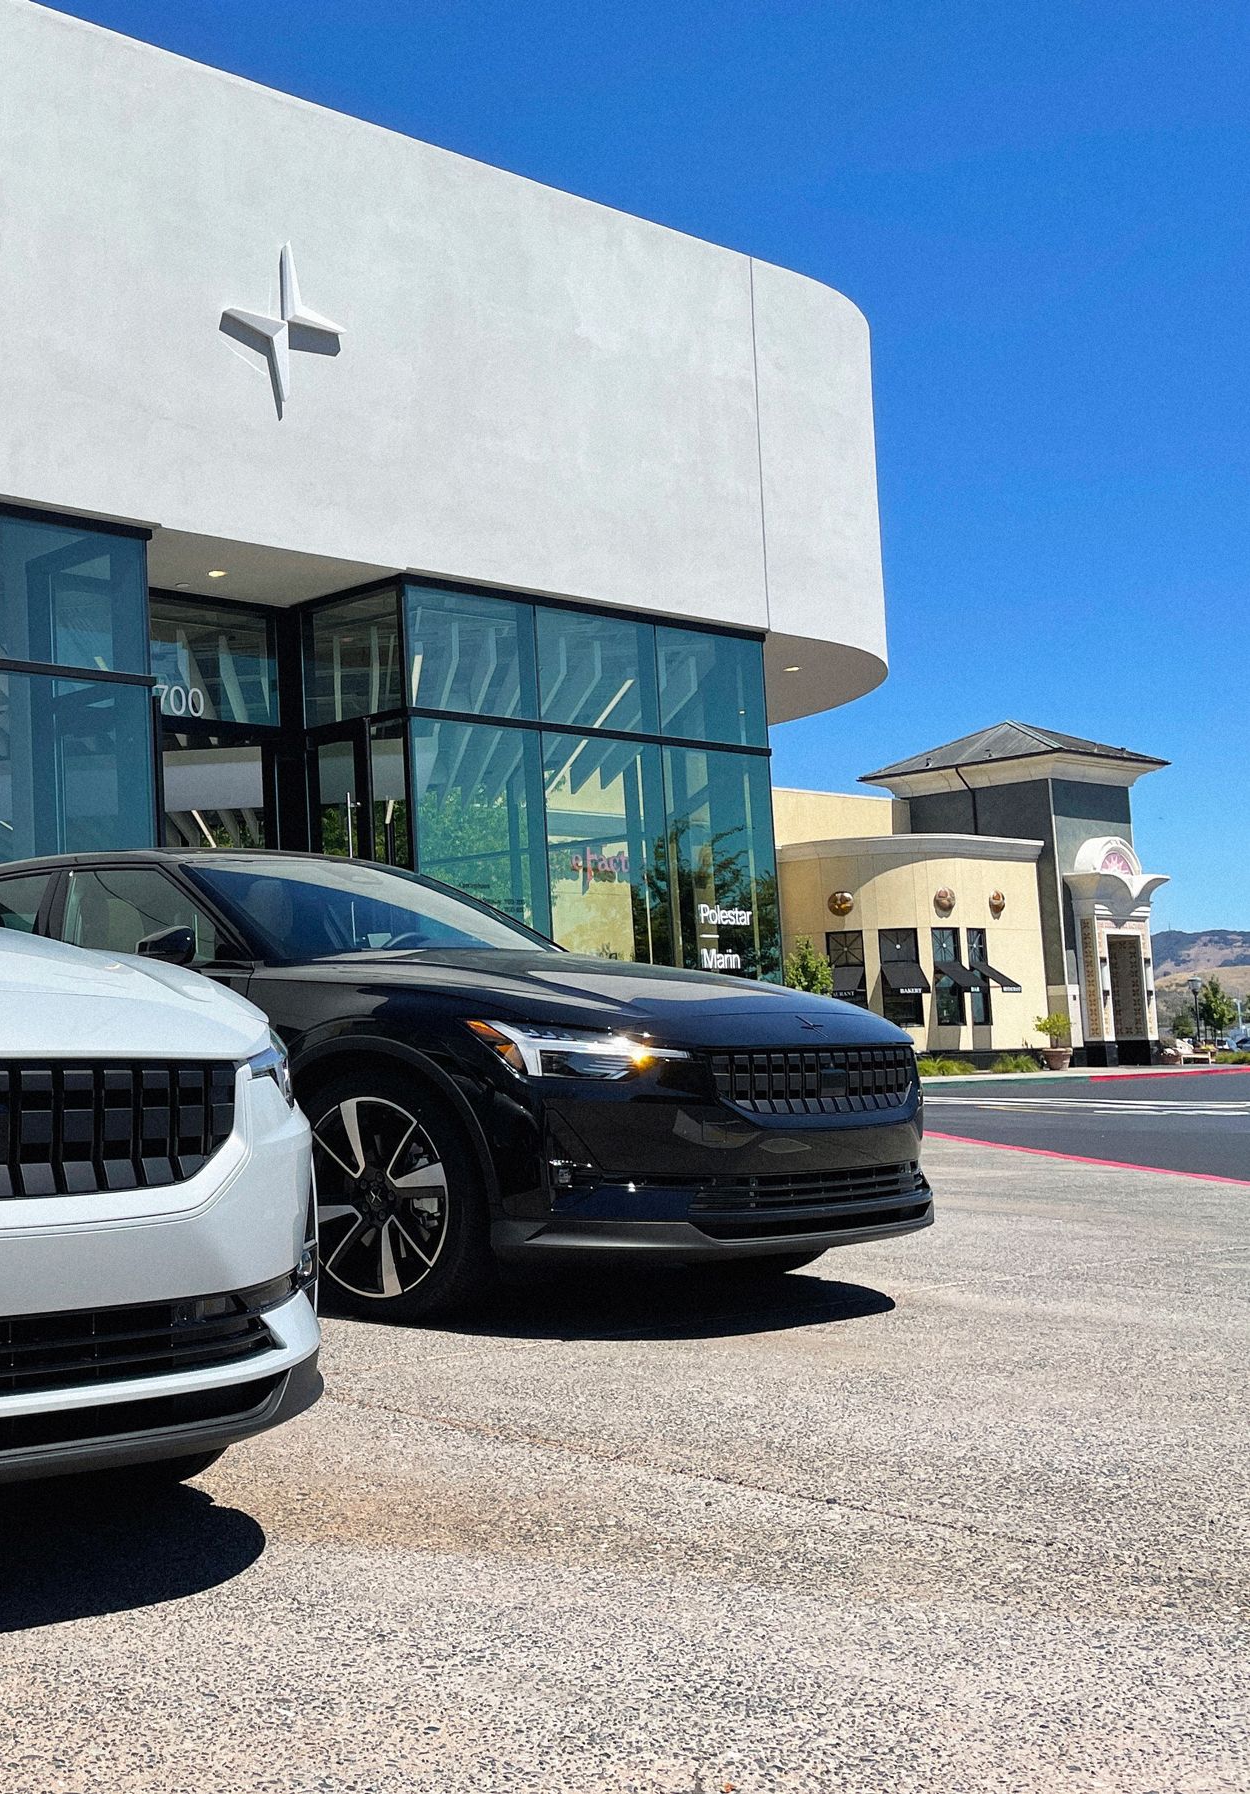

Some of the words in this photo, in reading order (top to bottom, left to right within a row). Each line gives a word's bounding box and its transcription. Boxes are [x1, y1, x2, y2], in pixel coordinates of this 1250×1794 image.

[154, 685, 204, 717] 700
[699, 904, 752, 926] Polestar
[701, 948, 741, 969] Marin
